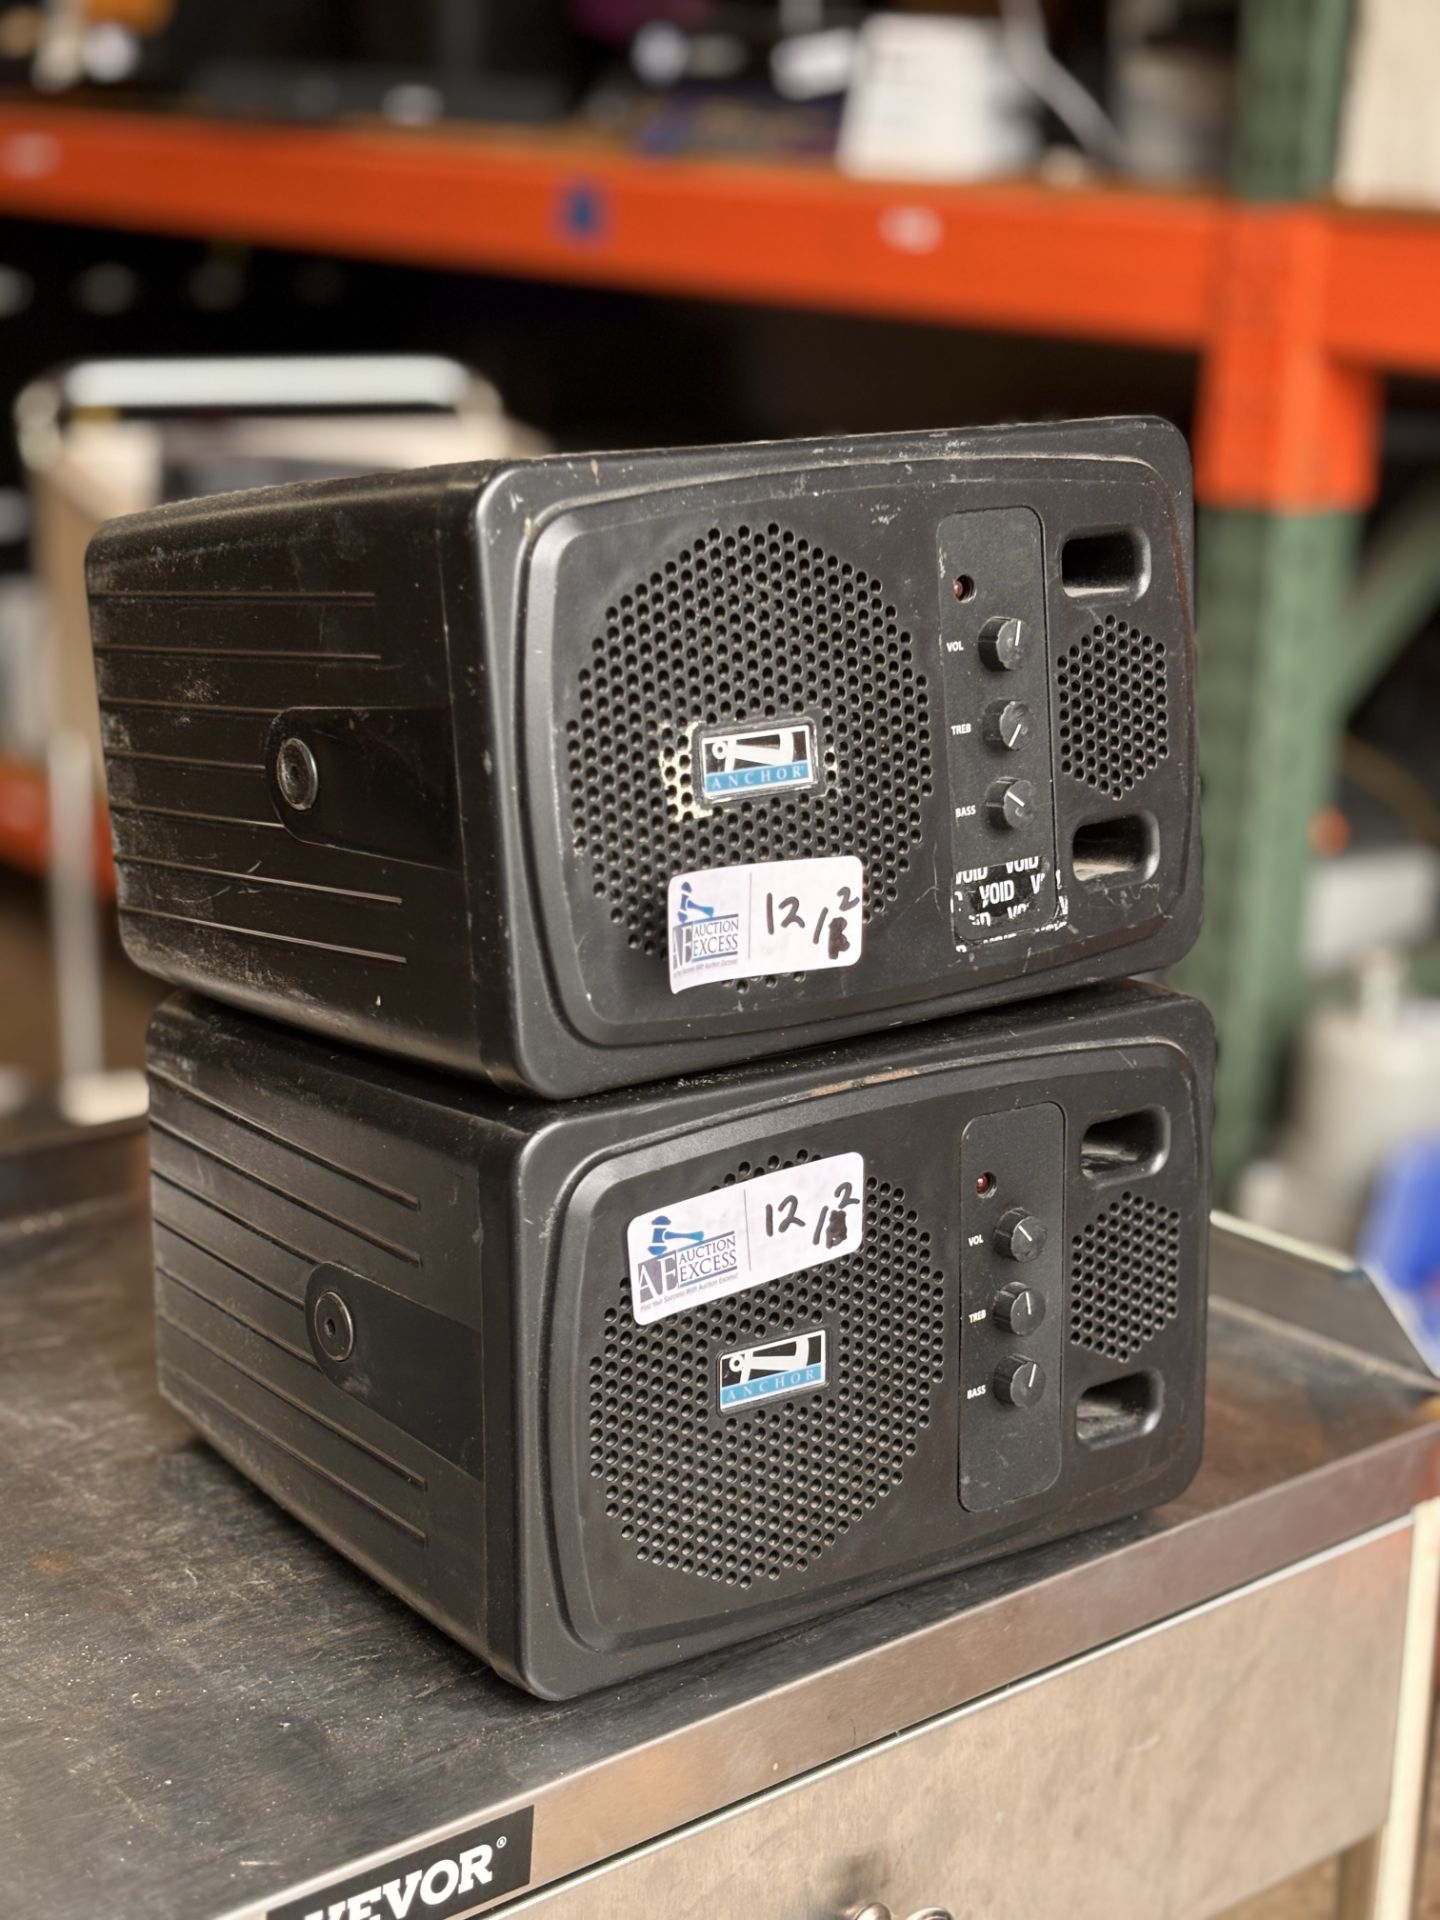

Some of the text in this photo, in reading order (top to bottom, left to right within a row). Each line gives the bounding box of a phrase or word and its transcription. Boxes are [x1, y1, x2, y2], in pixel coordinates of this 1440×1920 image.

[946, 640, 964, 653] VOL
[951, 723, 972, 735] TREB
[711, 764, 803, 789] ANCHOR
[955, 805, 976, 818] BASS
[979, 880, 1015, 908] VOID
[693, 919, 739, 937] AUCTION
[693, 934, 739, 956] EXCESS
[968, 1234, 984, 1247] VOL
[679, 1236, 736, 1265] AUCTION
[680, 1250, 737, 1281] EXCESS
[969, 1309, 987, 1324] TREB
[726, 1368, 816, 1401] ANCHOR
[967, 1385, 986, 1400] BASS
